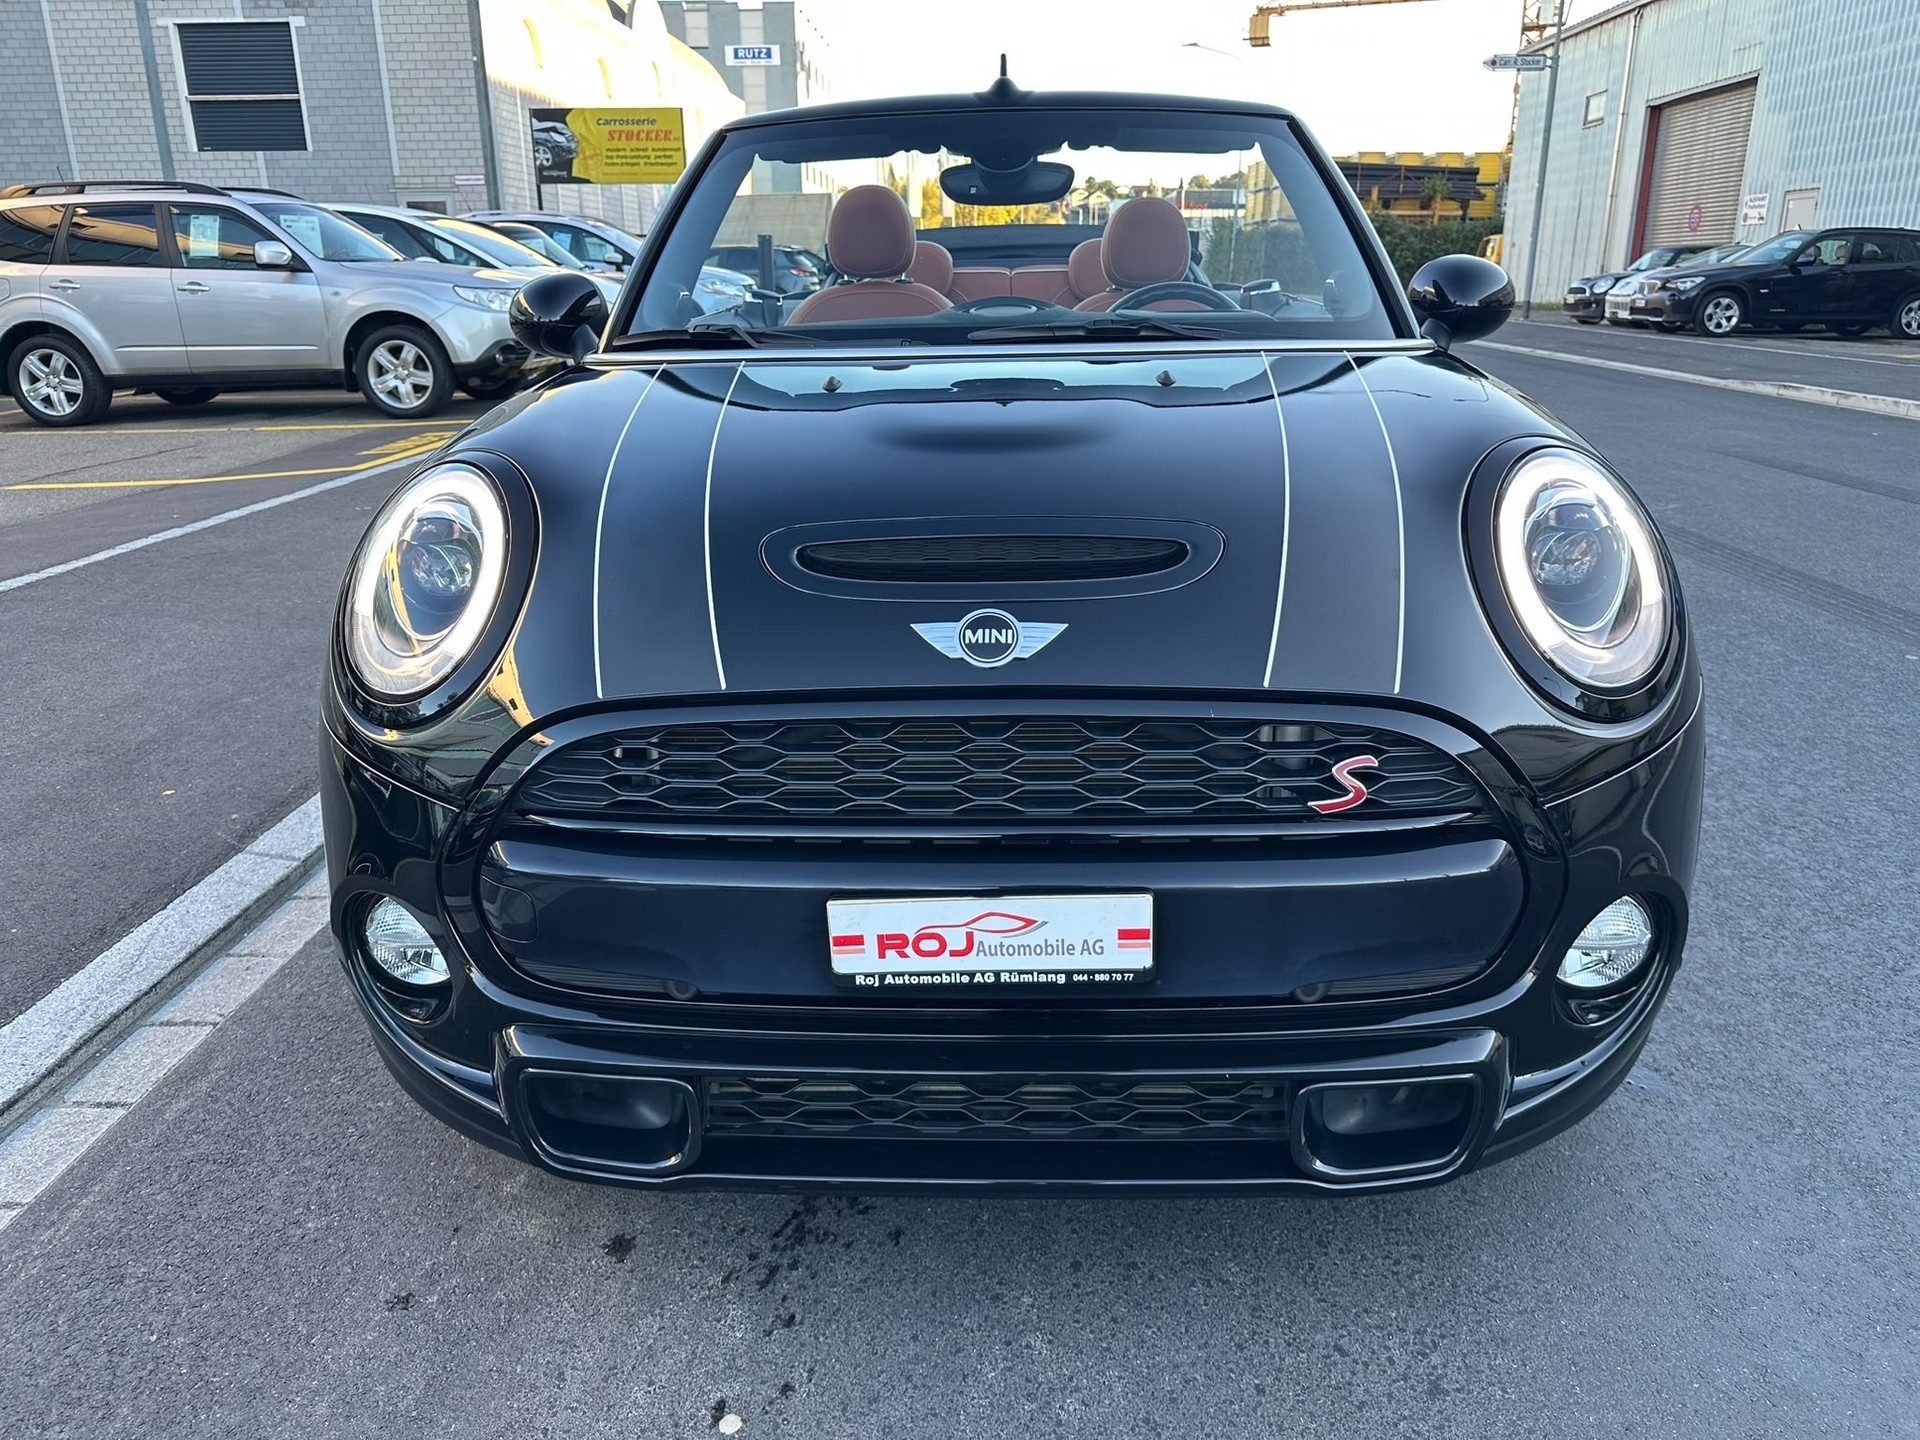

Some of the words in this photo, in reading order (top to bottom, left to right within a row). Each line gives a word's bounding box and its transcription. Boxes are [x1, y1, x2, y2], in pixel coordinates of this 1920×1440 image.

[737, 48, 768, 58] RUTZ
[596, 117, 657, 126] Carrosserie
[607, 129, 672, 142] STOCKER
[964, 628, 1013, 644] MINI
[1307, 754, 1379, 814] S
[876, 931, 974, 959] ROJ
[976, 939, 1076, 957] Automobile
[1080, 938, 1104, 956] AG
[855, 974, 879, 987] Roj
[884, 973, 970, 985] Automobile
[973, 972, 995, 983] AG
[1000, 971, 1066, 984] Rümlang
